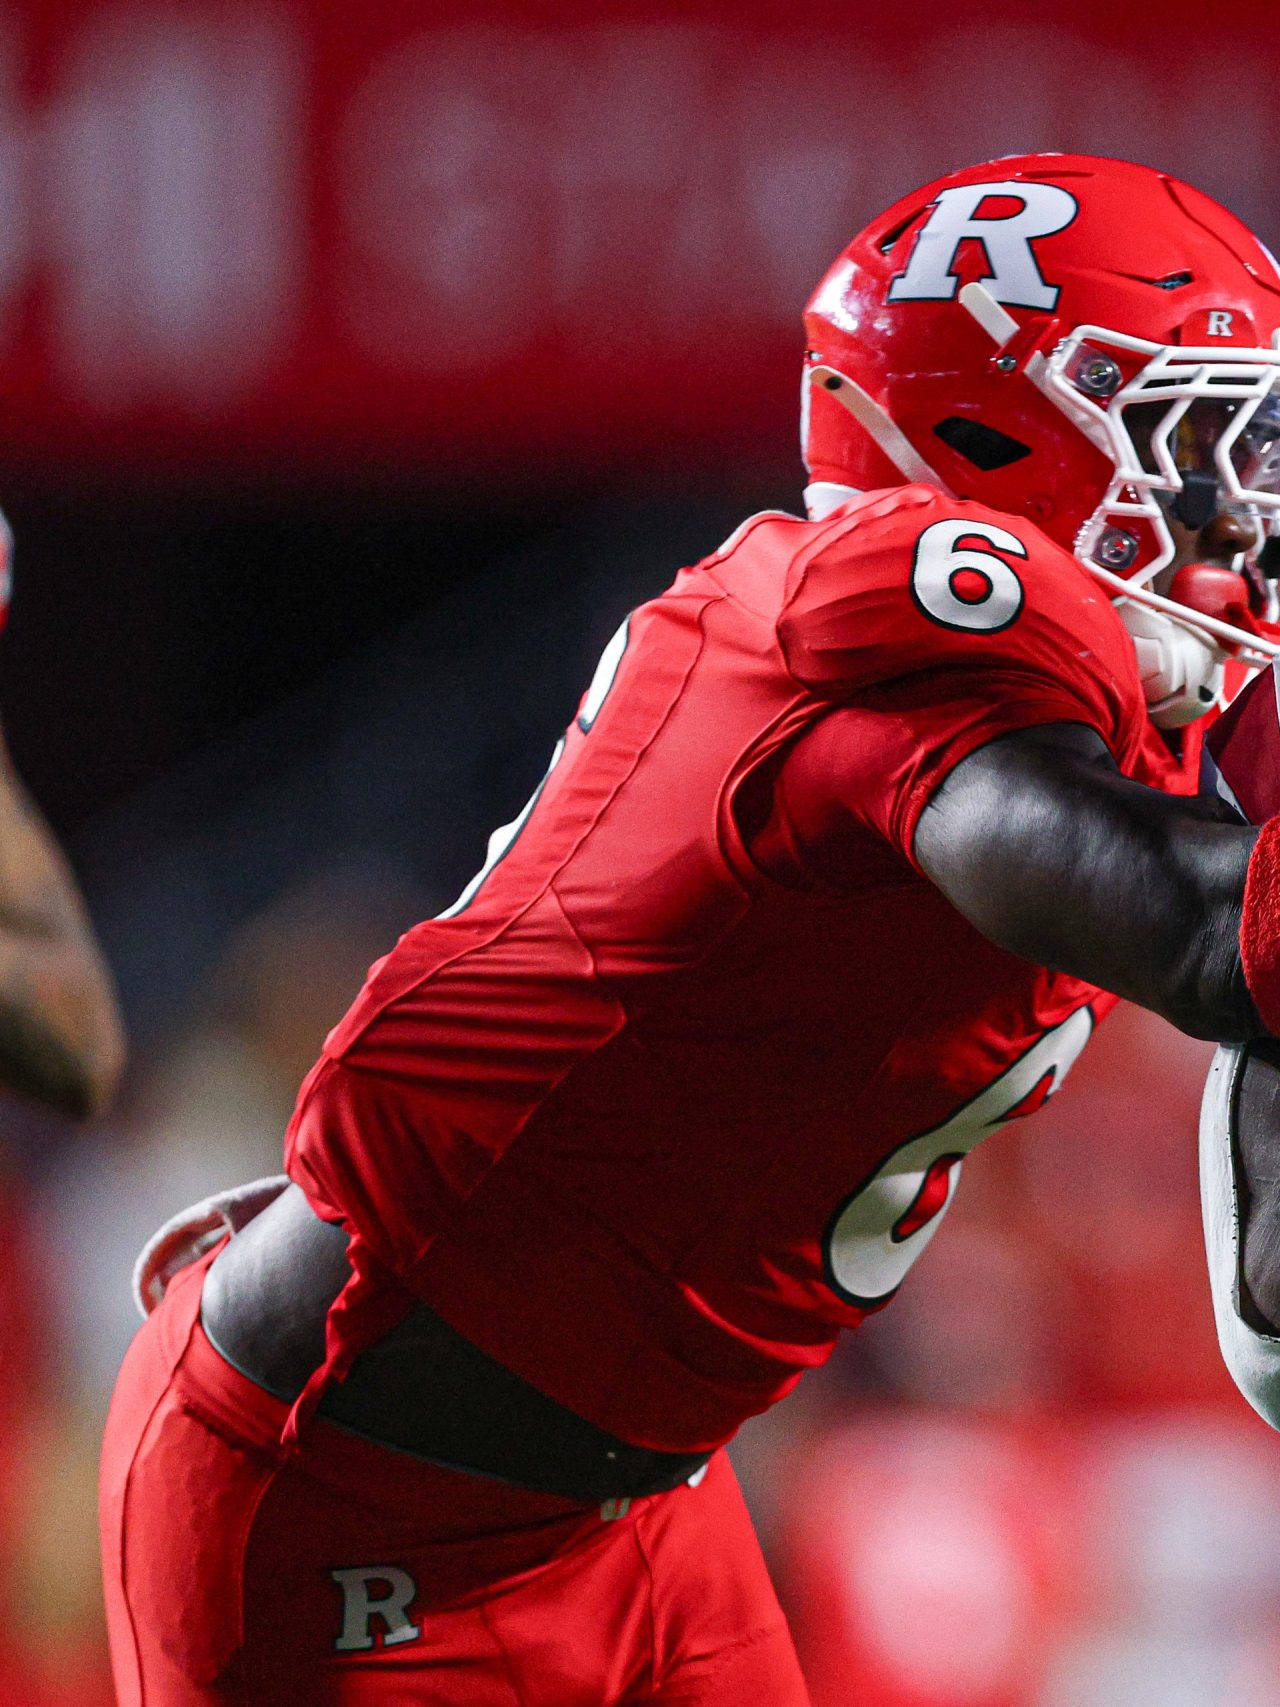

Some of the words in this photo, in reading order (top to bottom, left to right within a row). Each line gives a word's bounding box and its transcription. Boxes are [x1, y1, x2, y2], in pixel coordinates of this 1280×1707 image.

[887, 180, 1078, 311] R
[1206, 310, 1234, 337] R
[913, 518, 1028, 634] 6
[822, 1004, 1095, 1308] 6
[329, 1566, 421, 1652] R
